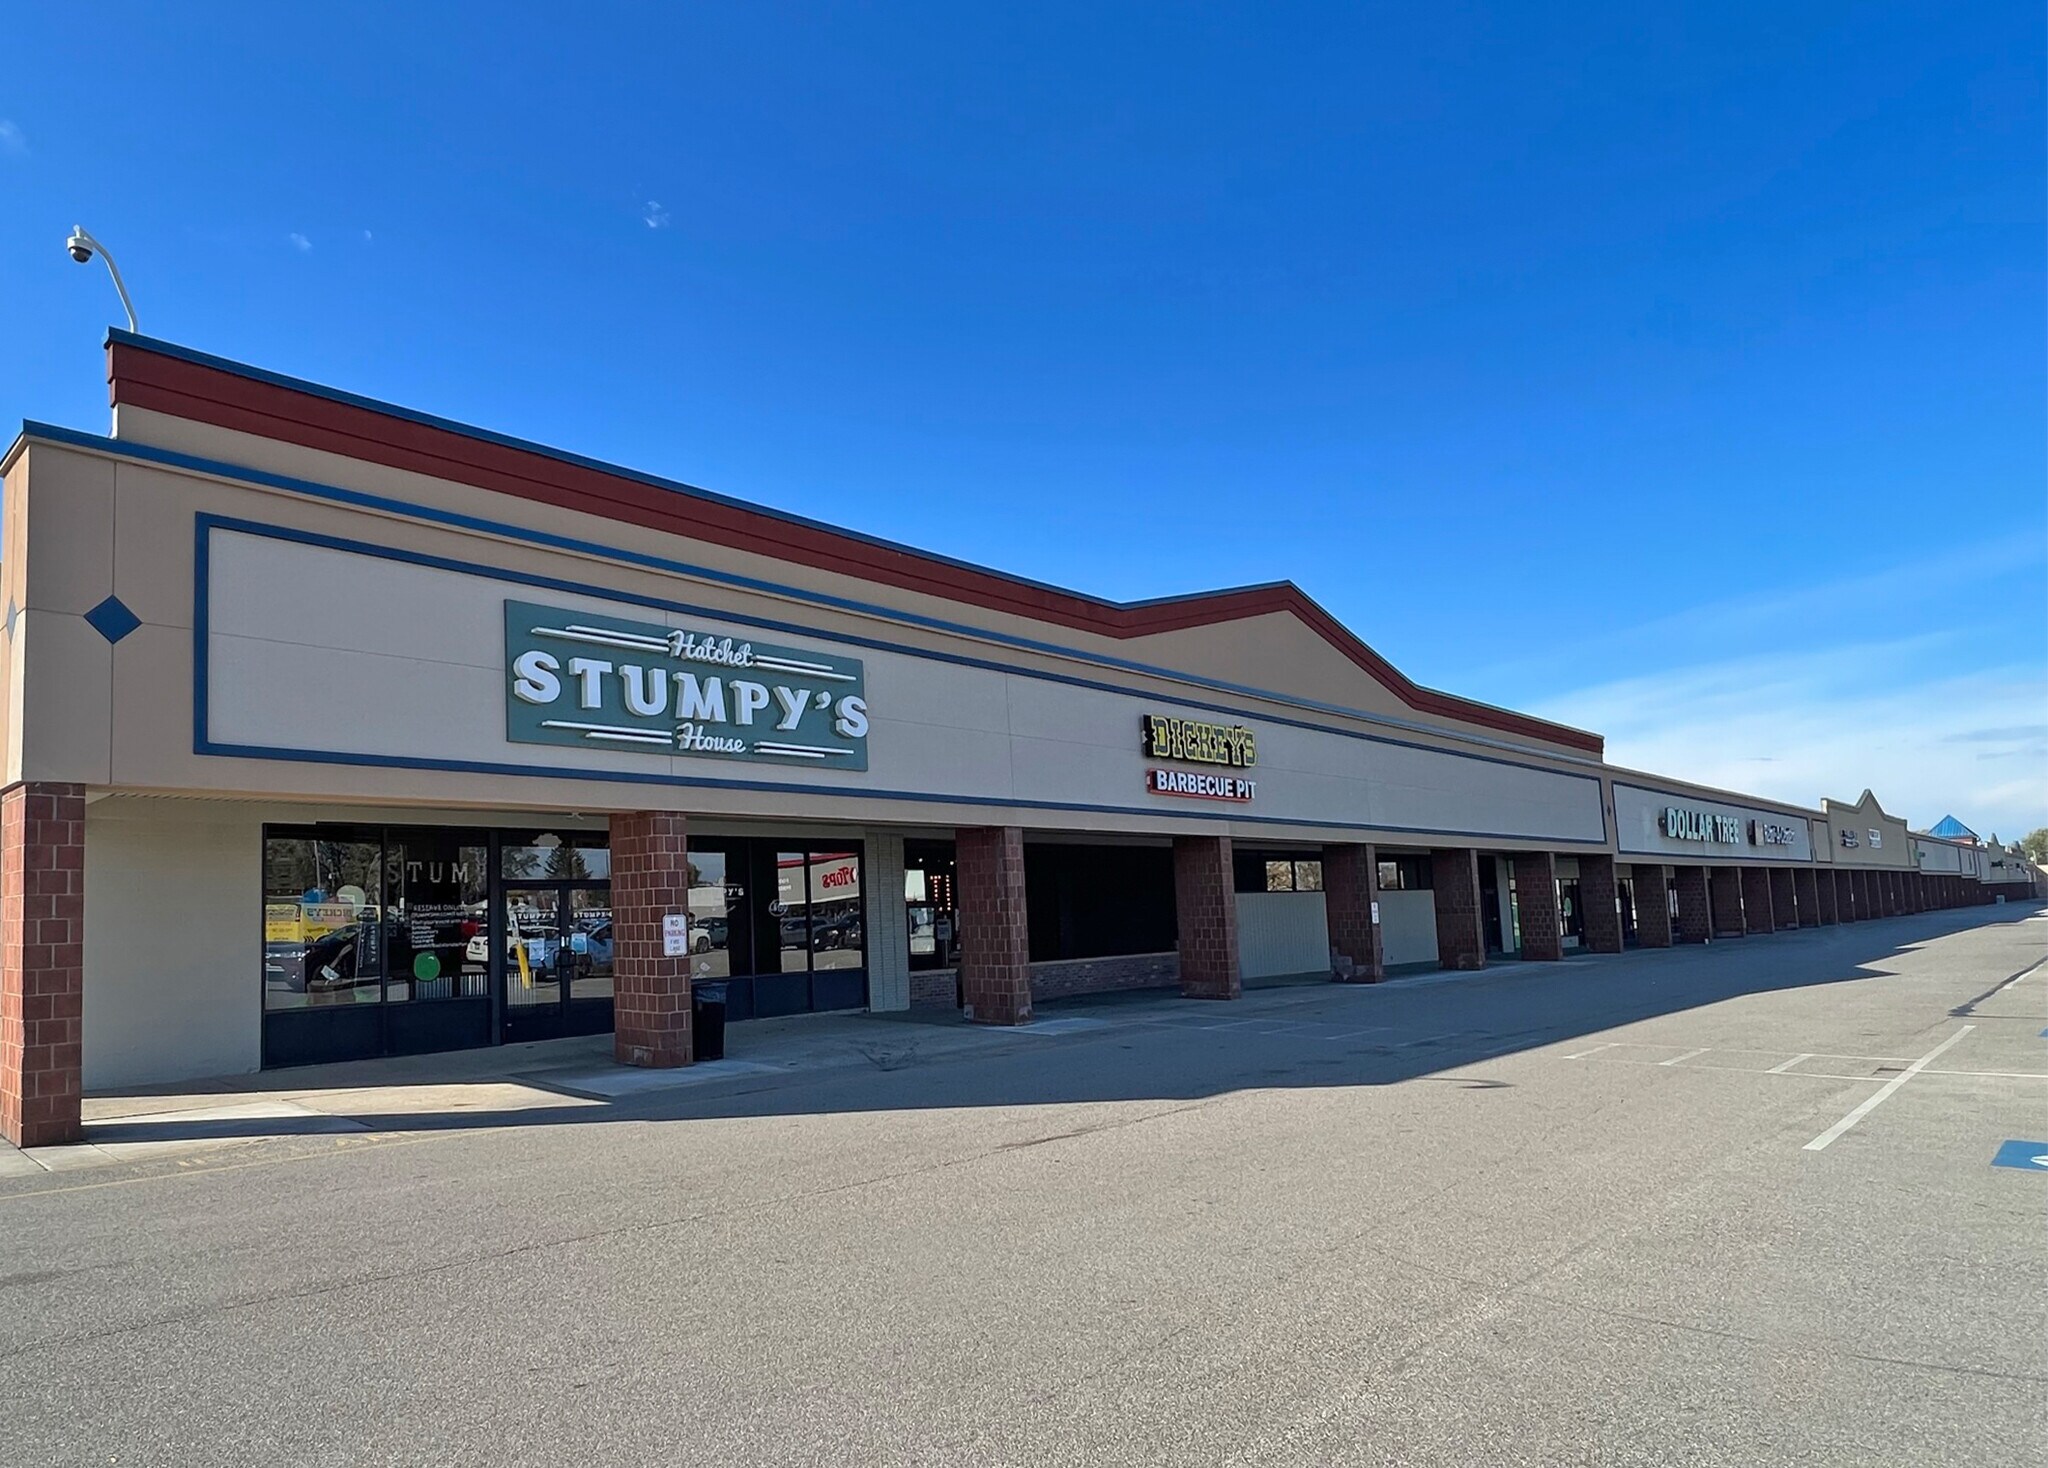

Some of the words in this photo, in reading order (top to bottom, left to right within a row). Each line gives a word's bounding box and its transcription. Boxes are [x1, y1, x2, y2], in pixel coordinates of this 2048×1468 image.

[668, 629, 754, 668] Hatchet
[513, 650, 869, 738] STUMPY'S
[676, 721, 747, 754] House
[1156, 769, 1233, 798] BARBECUE
[1236, 779, 1257, 799] PIT
[1666, 807, 1714, 843] DOLLAR
[1715, 815, 1740, 844] TREE
[670, 919, 679, 927] NO
